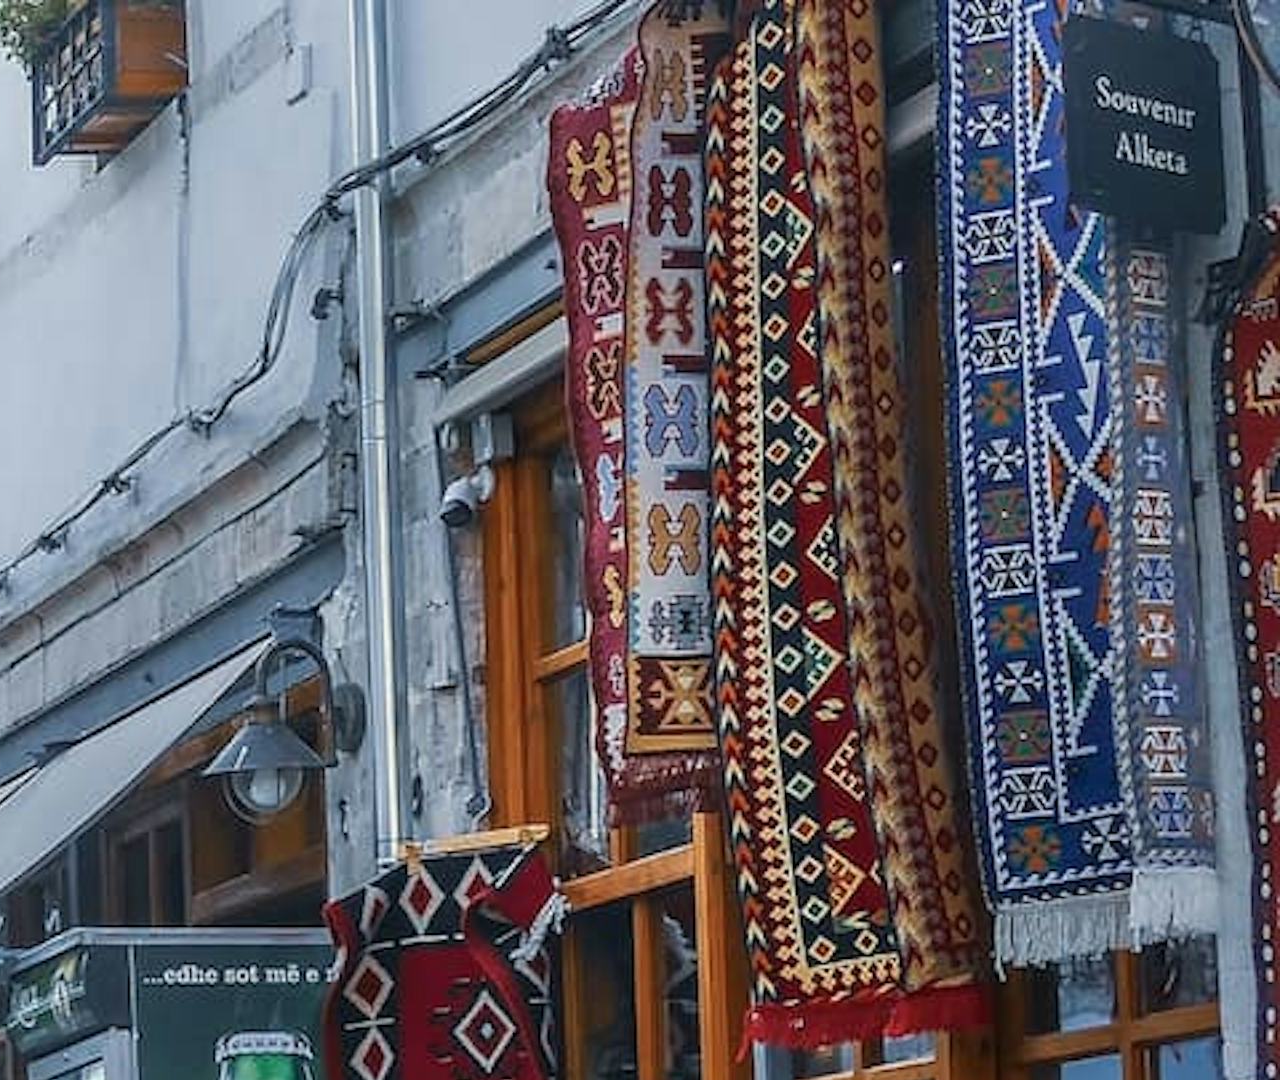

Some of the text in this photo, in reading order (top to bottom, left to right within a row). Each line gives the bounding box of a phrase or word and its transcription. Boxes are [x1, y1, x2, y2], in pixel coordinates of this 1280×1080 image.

[1094, 74, 1197, 130] Souvenir
[1114, 130, 1190, 175] Alketa
[223, 964, 259, 984] sot
[265, 963, 301, 984] më
[305, 967, 320, 983] e
